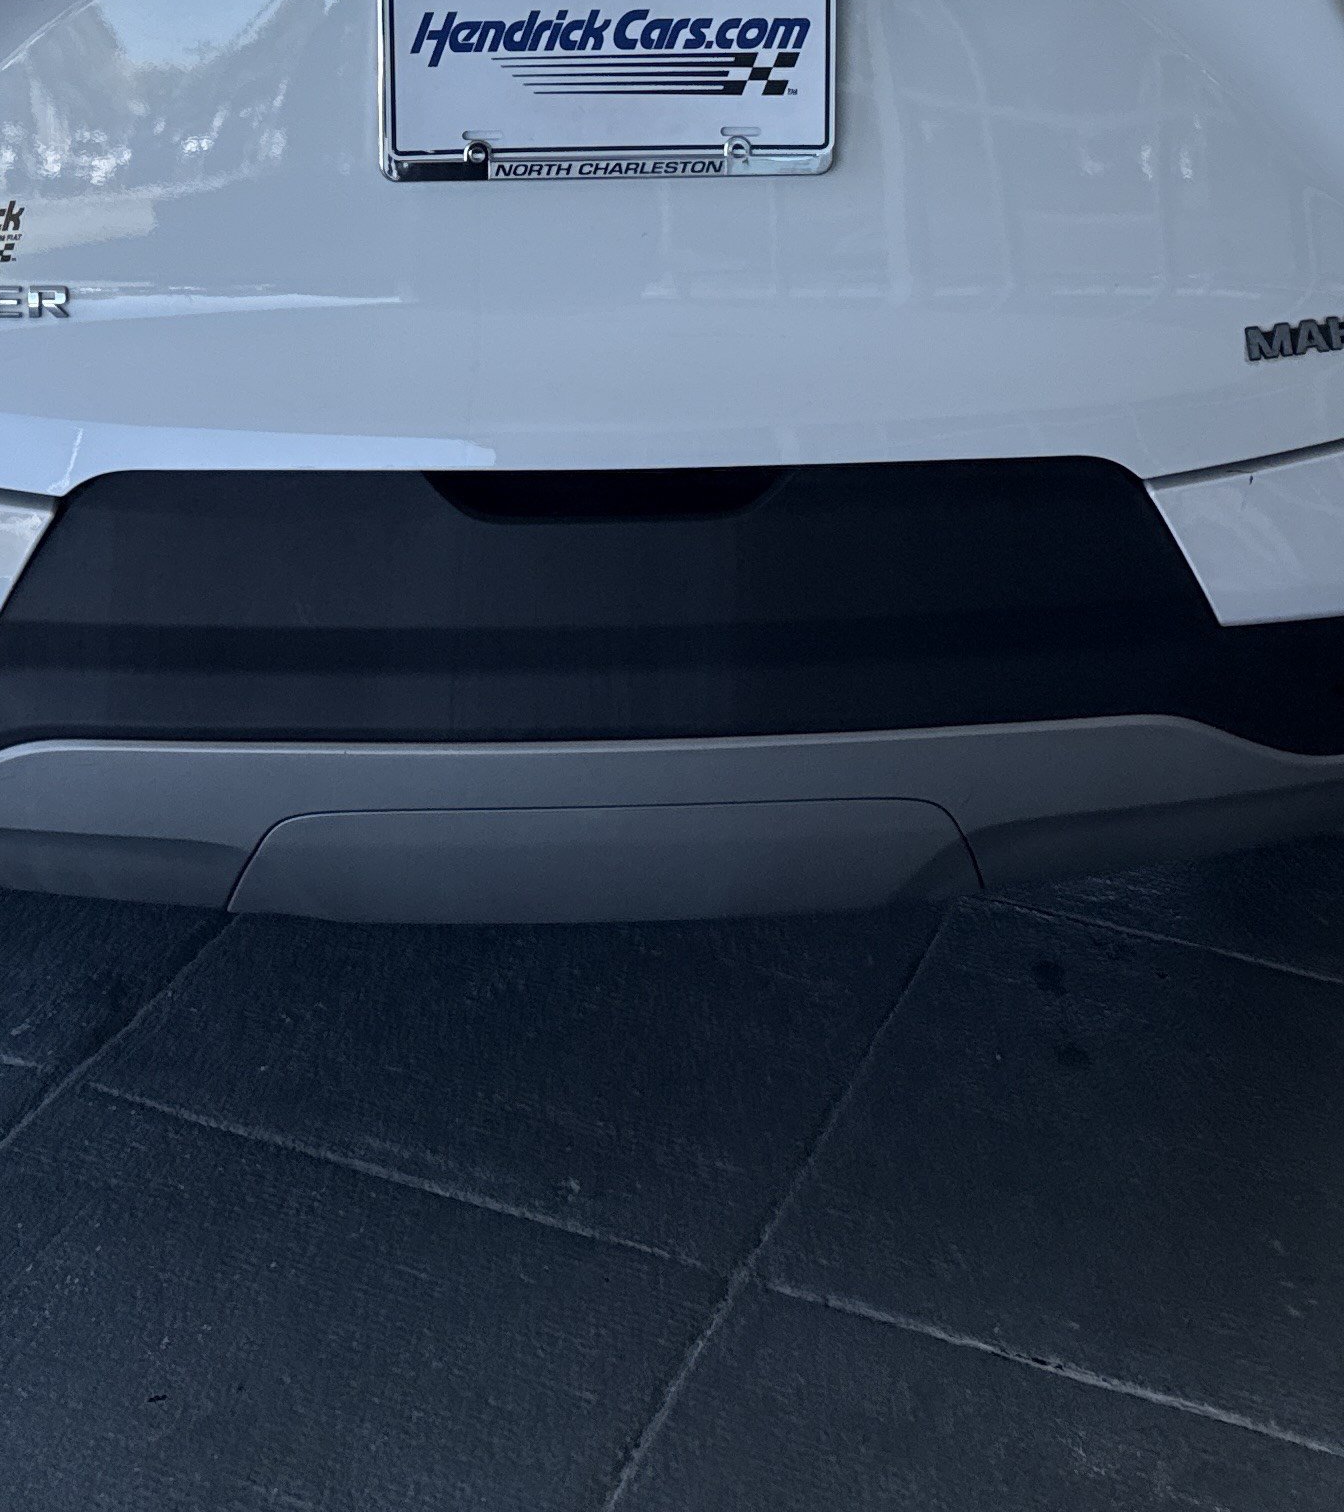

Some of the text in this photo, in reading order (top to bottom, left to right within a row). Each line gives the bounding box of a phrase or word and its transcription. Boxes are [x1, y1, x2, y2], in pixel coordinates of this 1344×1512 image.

[494, 159, 724, 177] NORTH CHARLESTON
[6, 233, 23, 242] FIAT
